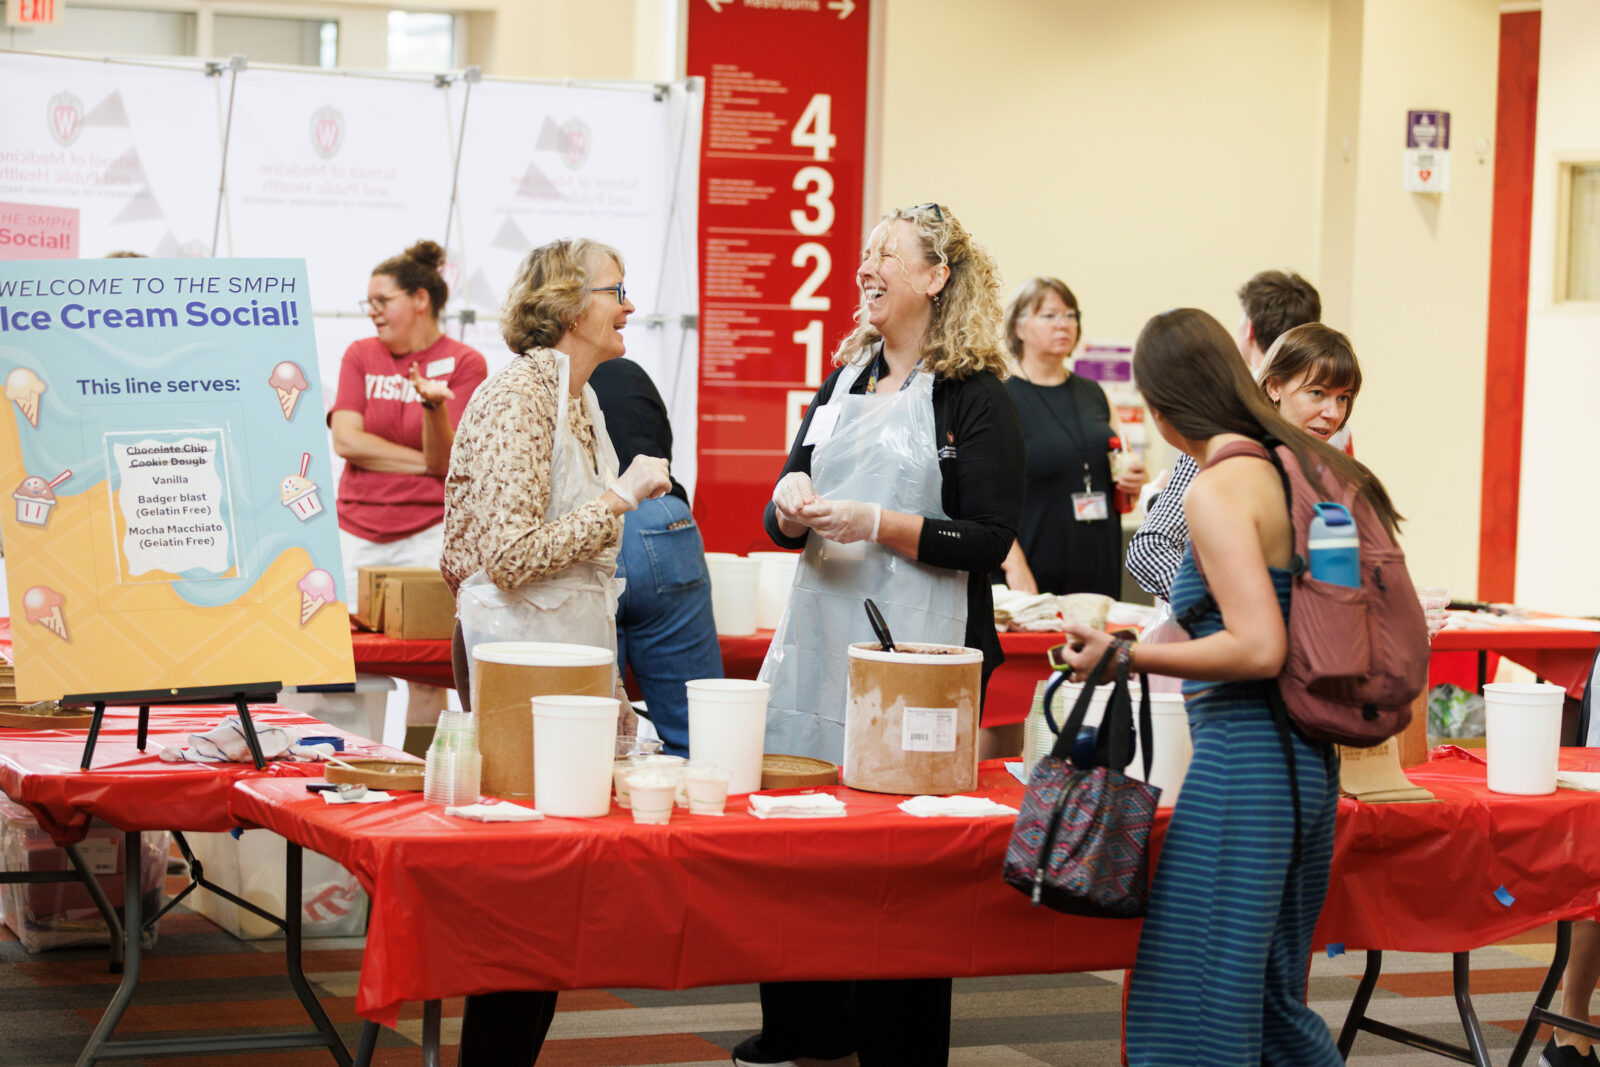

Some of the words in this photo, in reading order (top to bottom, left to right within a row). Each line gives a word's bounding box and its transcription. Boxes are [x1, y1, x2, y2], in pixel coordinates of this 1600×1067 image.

[791, 93, 836, 161] 4
[791, 165, 836, 236] 3
[0, 210, 23, 226] HE
[27, 212, 73, 229] SMPH
[0, 227, 71, 251] Social!
[790, 241, 832, 312] 2
[0, 278, 124, 298] WELCOME
[132, 277, 165, 295] TO
[173, 276, 221, 294] THE
[228, 276, 296, 294] SMPH
[0, 305, 52, 332] Ice
[60, 303, 179, 330] Cream
[185, 298, 300, 327] Social!
[792, 319, 824, 388] 1
[76, 377, 122, 396] This
[126, 377, 162, 394] line
[166, 378, 241, 393] serves:
[126, 445, 181, 456] Chocolate
[183, 443, 208, 455] Chip
[130, 458, 169, 468] Cookie
[170, 456, 207, 468] Dough
[152, 475, 189, 485] Vanilla
[138, 494, 177, 505] Badger
[179, 492, 207, 502] blast
[136, 506, 181, 519] (Gelatin
[182, 505, 212, 516] Free)
[128, 525, 165, 536] Mocha
[167, 522, 223, 534] Macchiato
[139, 537, 184, 551] (Gelatin
[185, 536, 215, 547] Free)
